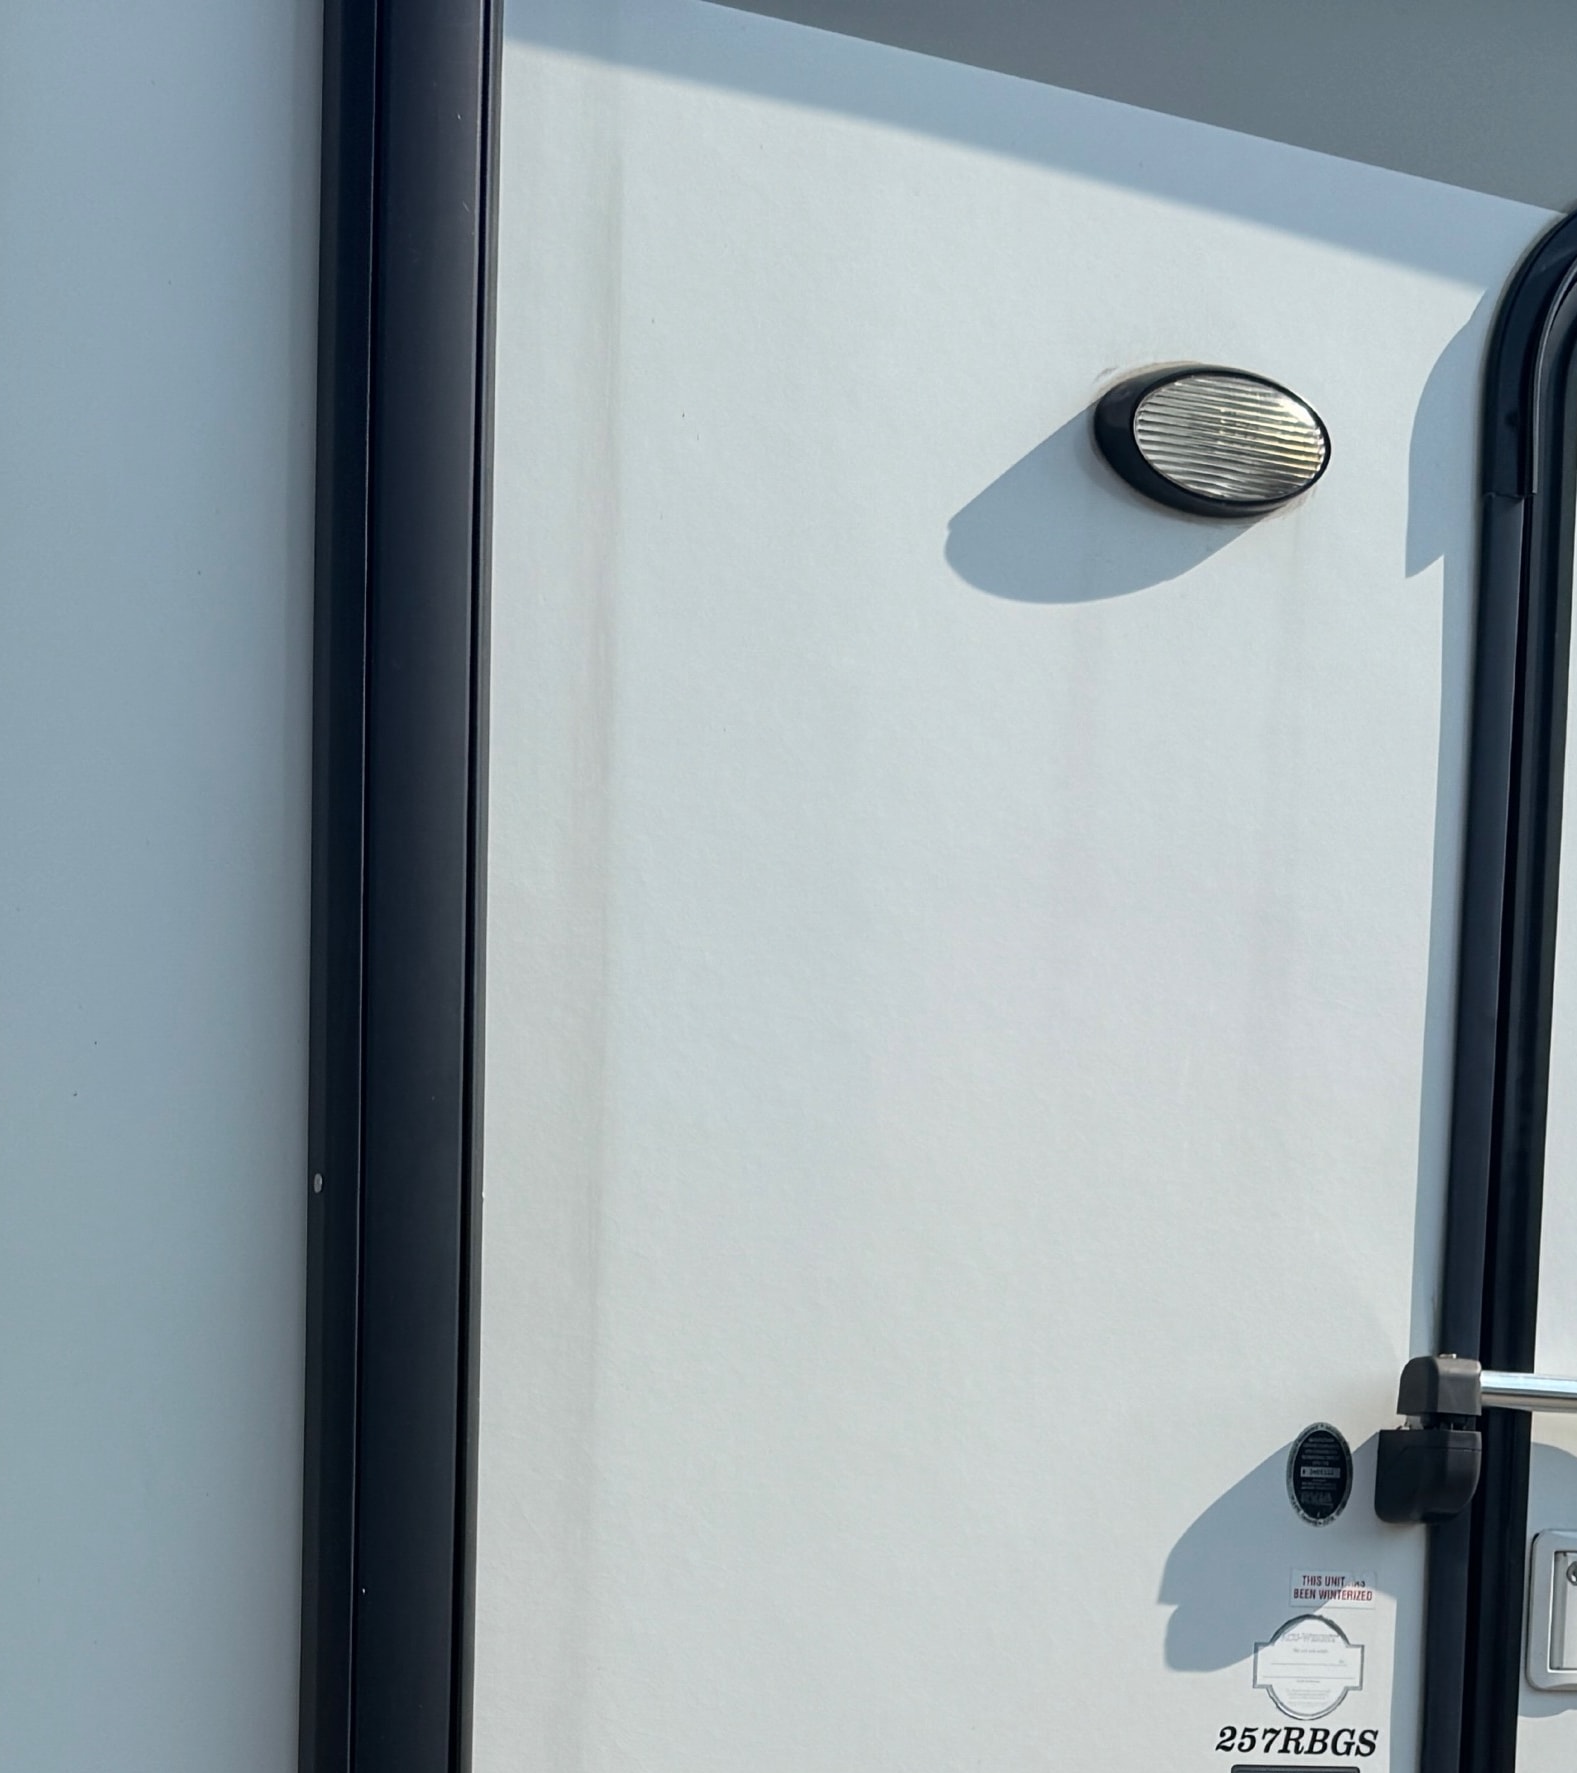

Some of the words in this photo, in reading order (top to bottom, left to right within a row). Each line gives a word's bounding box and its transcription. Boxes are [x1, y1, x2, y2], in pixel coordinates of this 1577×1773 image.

[1302, 1575, 1322, 1587] THIS
[1325, 1575, 1345, 1588] UNIT
[1293, 1588, 1316, 1600] BEEN
[1319, 1588, 1373, 1602] WINTERIZED
[1215, 1725, 1379, 1758] 257RBGS
